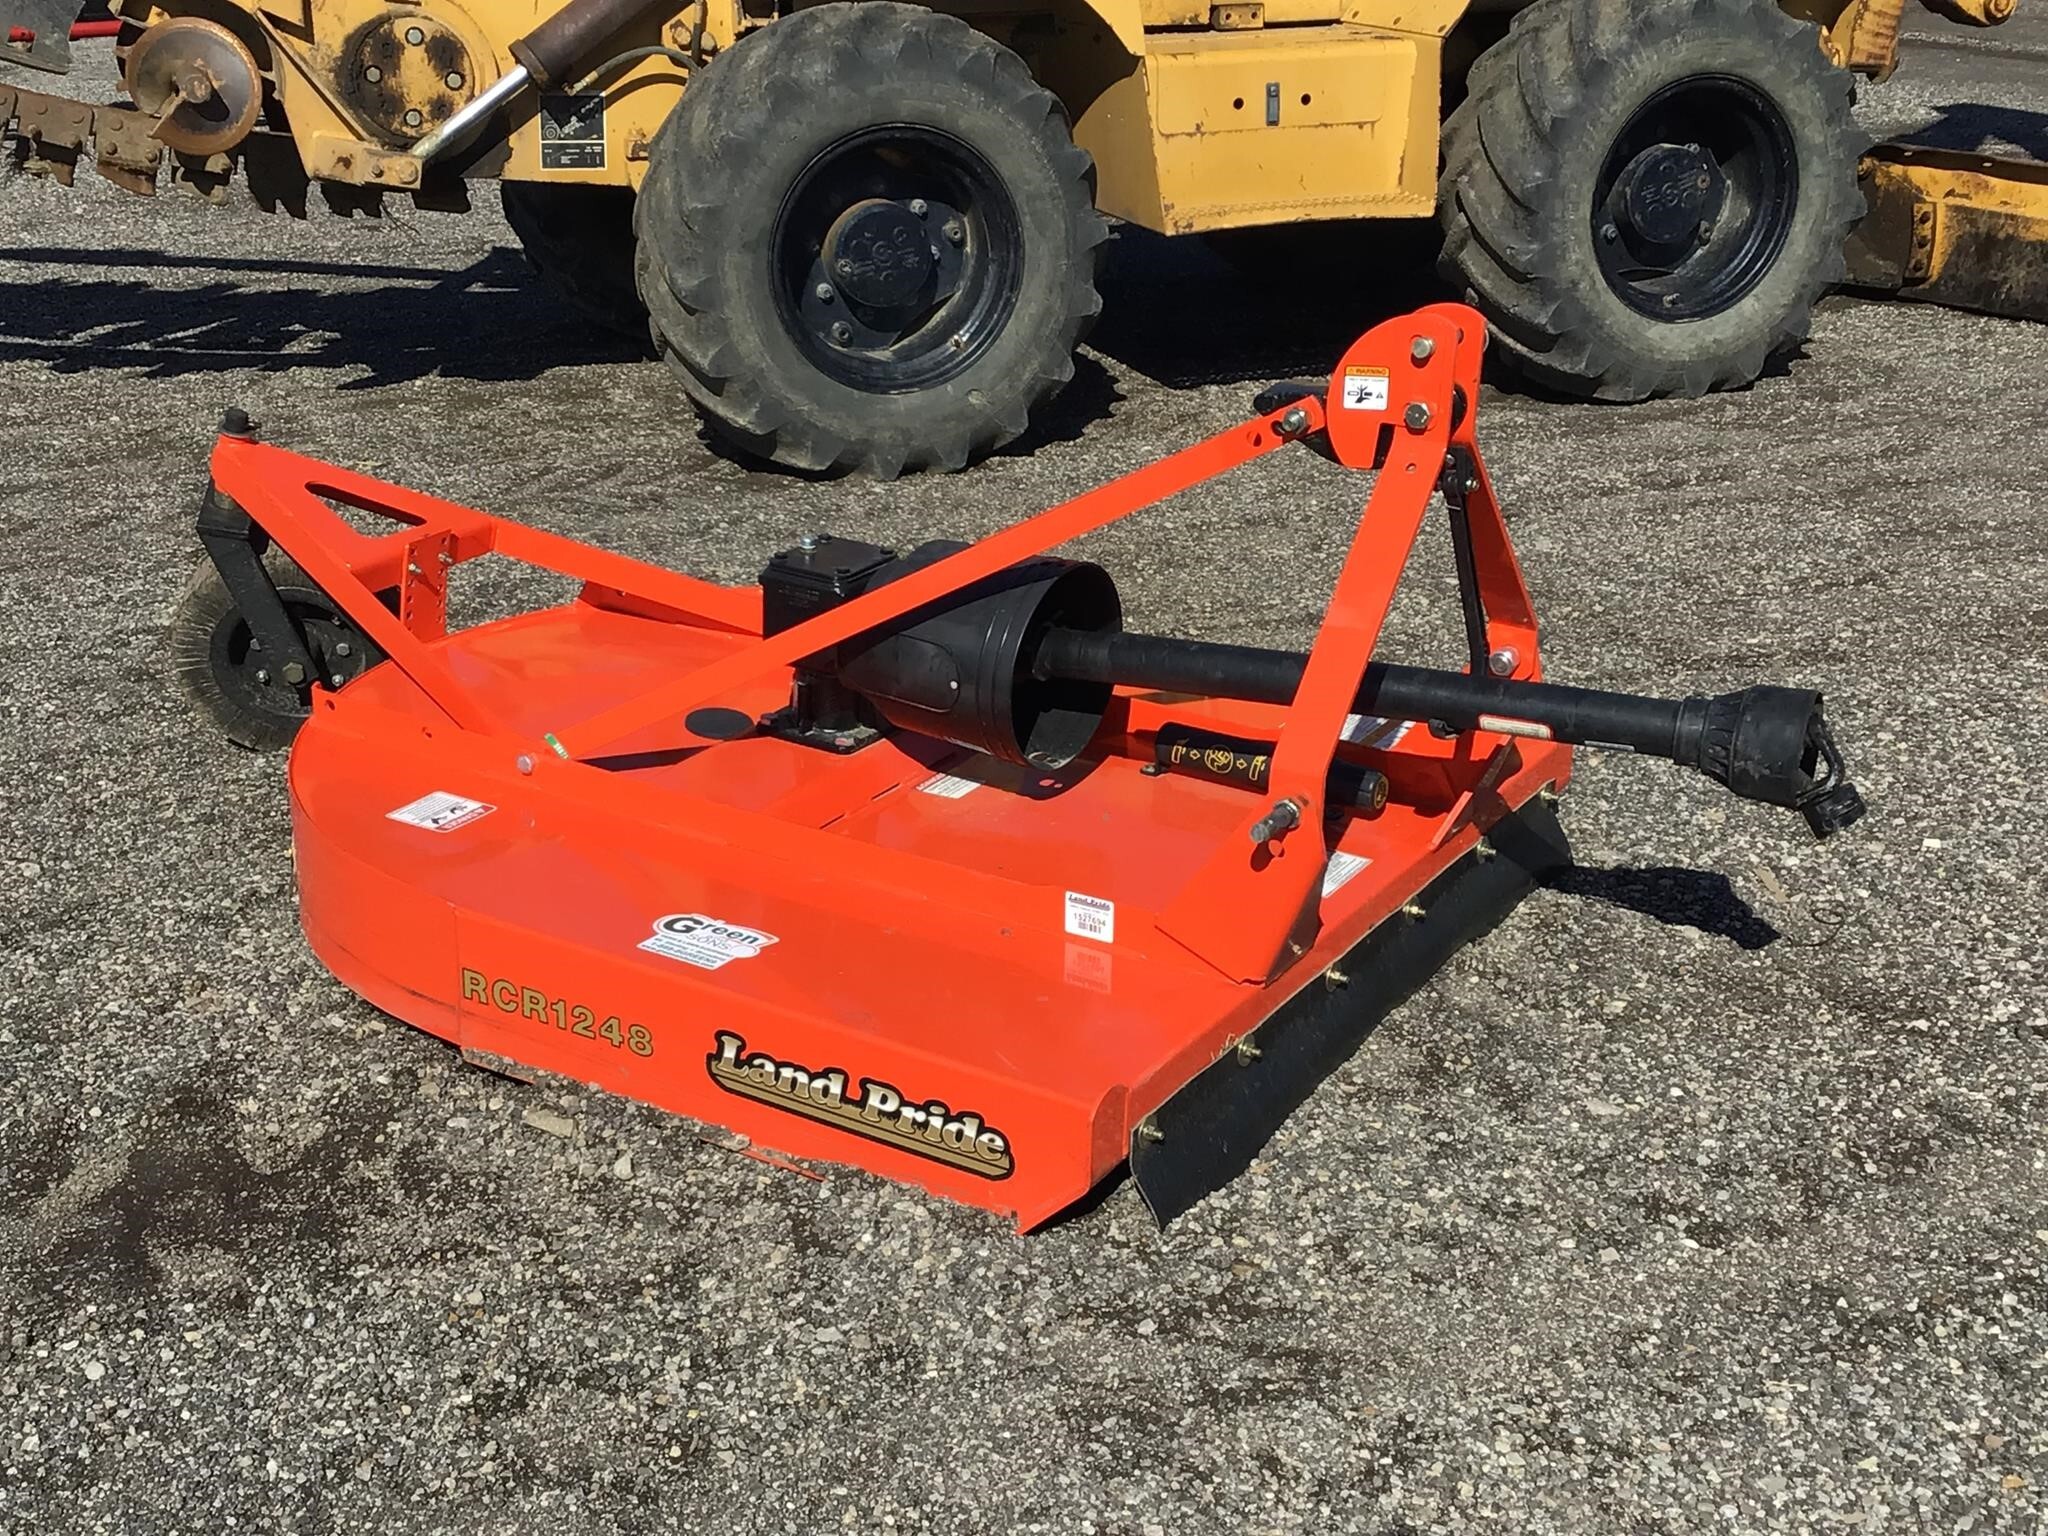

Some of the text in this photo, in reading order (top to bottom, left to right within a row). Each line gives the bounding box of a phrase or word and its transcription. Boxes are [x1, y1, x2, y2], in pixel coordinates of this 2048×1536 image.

[663, 916, 760, 945] Green
[461, 967, 654, 1057] RCR1248
[714, 1033, 1007, 1161] Land Pride
